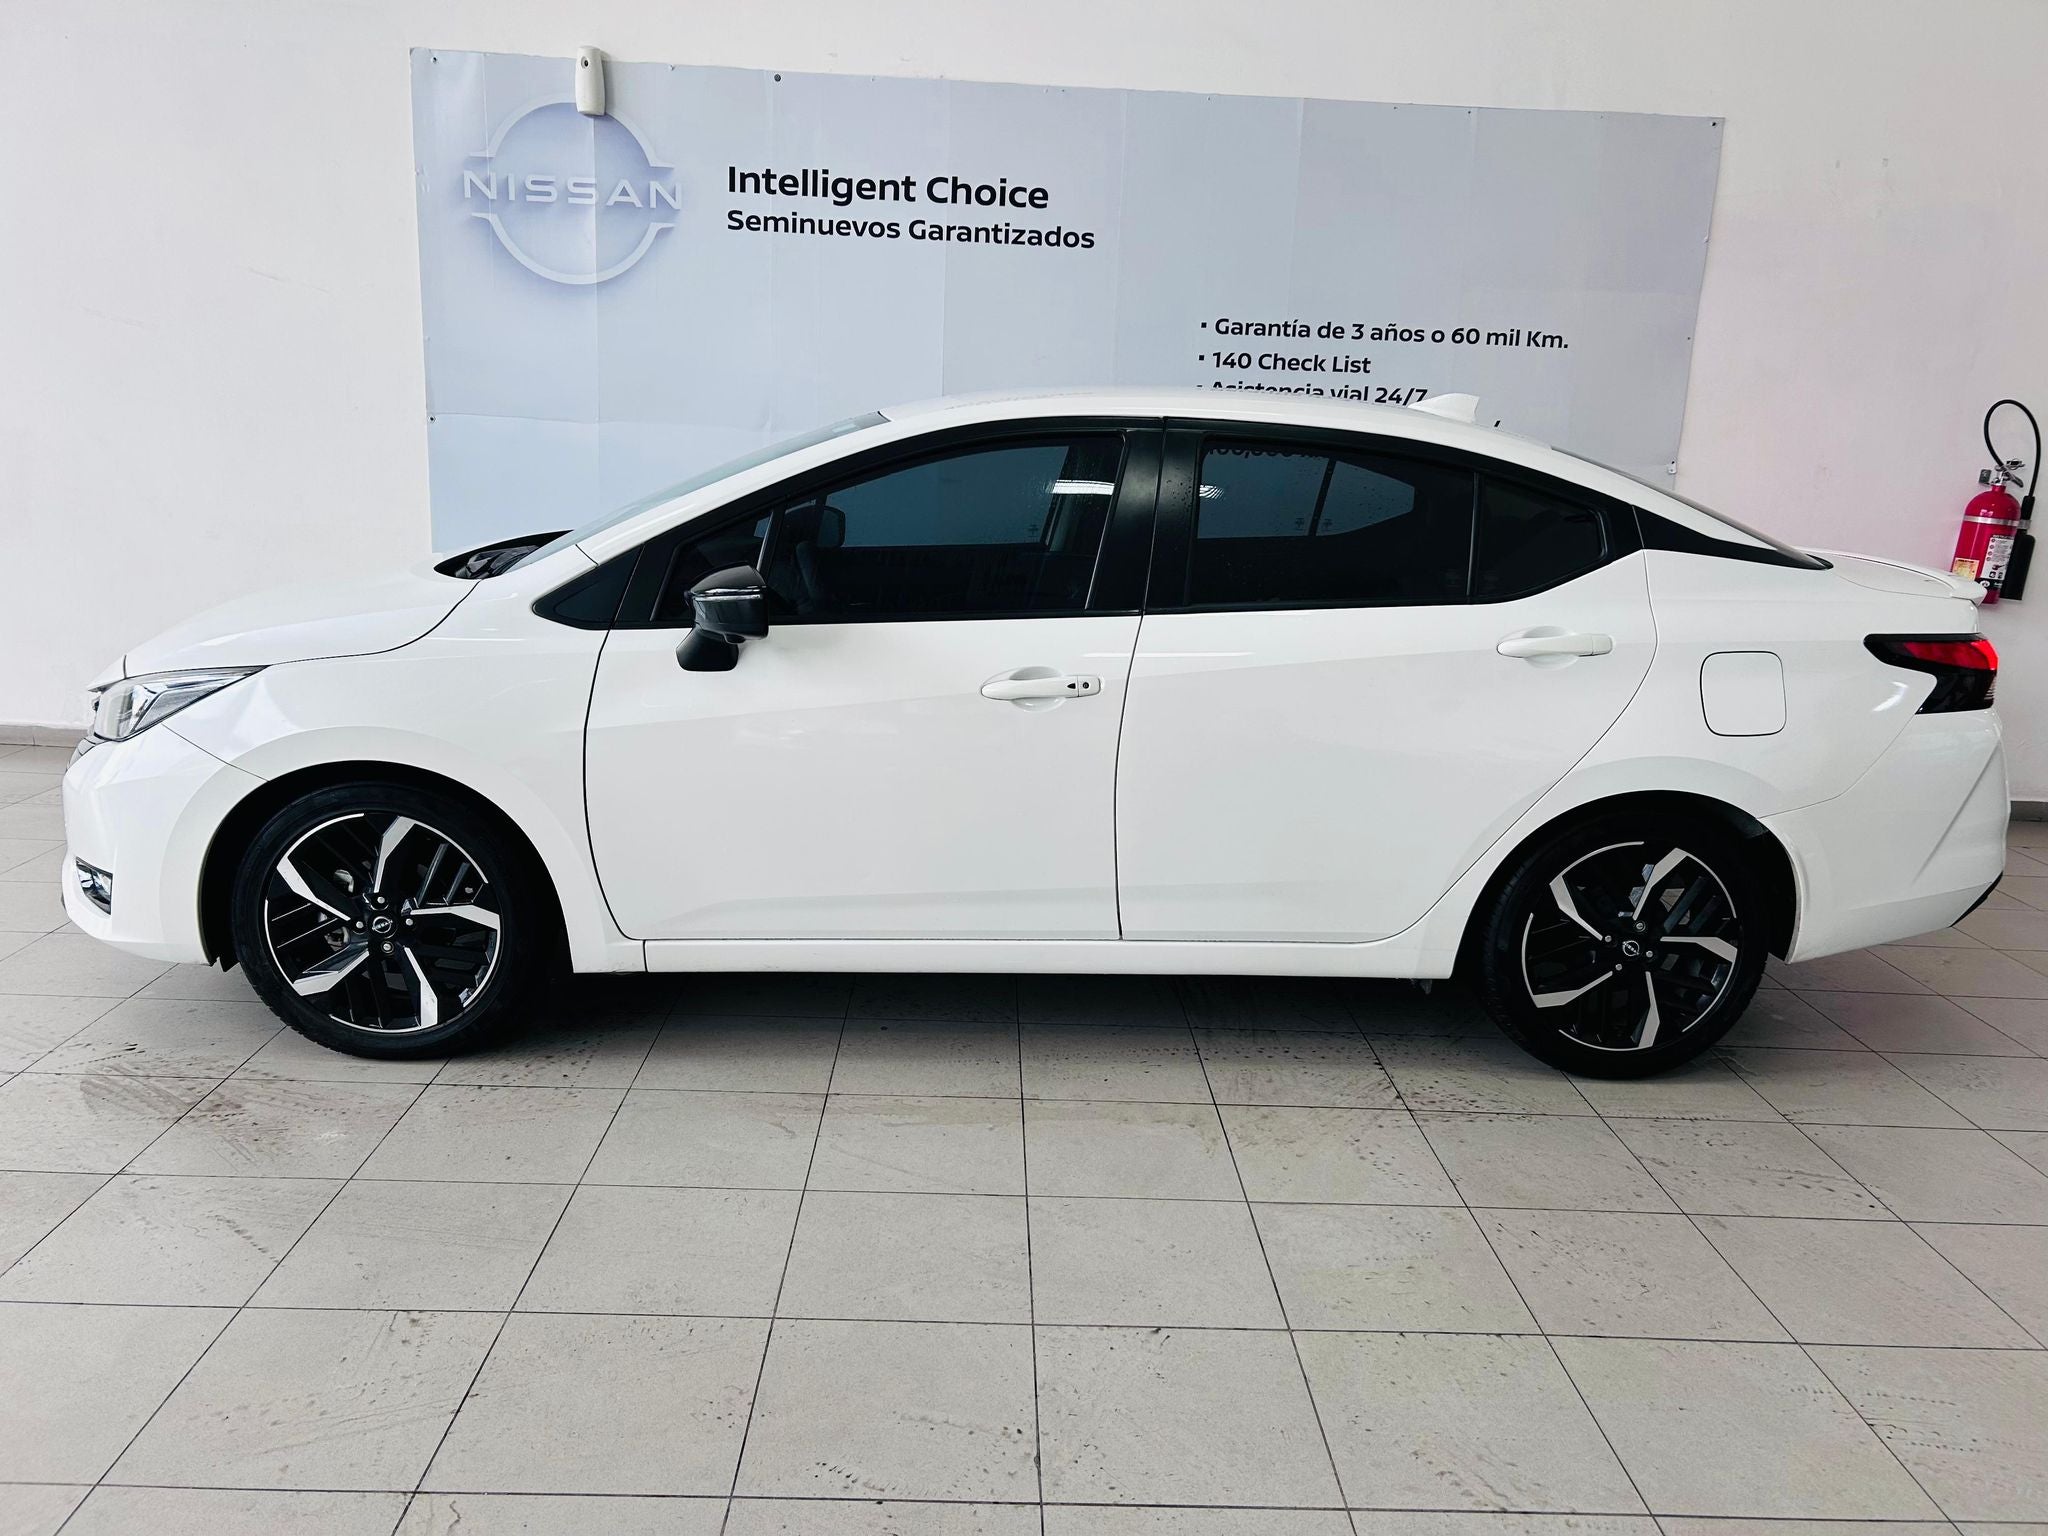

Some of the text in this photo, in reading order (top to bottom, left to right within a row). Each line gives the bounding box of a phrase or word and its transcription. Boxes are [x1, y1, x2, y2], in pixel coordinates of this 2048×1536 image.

[463, 169, 682, 210] NISSAN
[728, 166, 1049, 209] Intelligent Choice
[727, 209, 1095, 249] Seminuevos Garantizados
[1214, 318, 1569, 349] Garantía de 3 años o 60 mil Km.
[1212, 351, 1372, 374] 140 Check List
[1330, 384, 1369, 402] vial
[1374, 387, 1428, 406] 24/7
